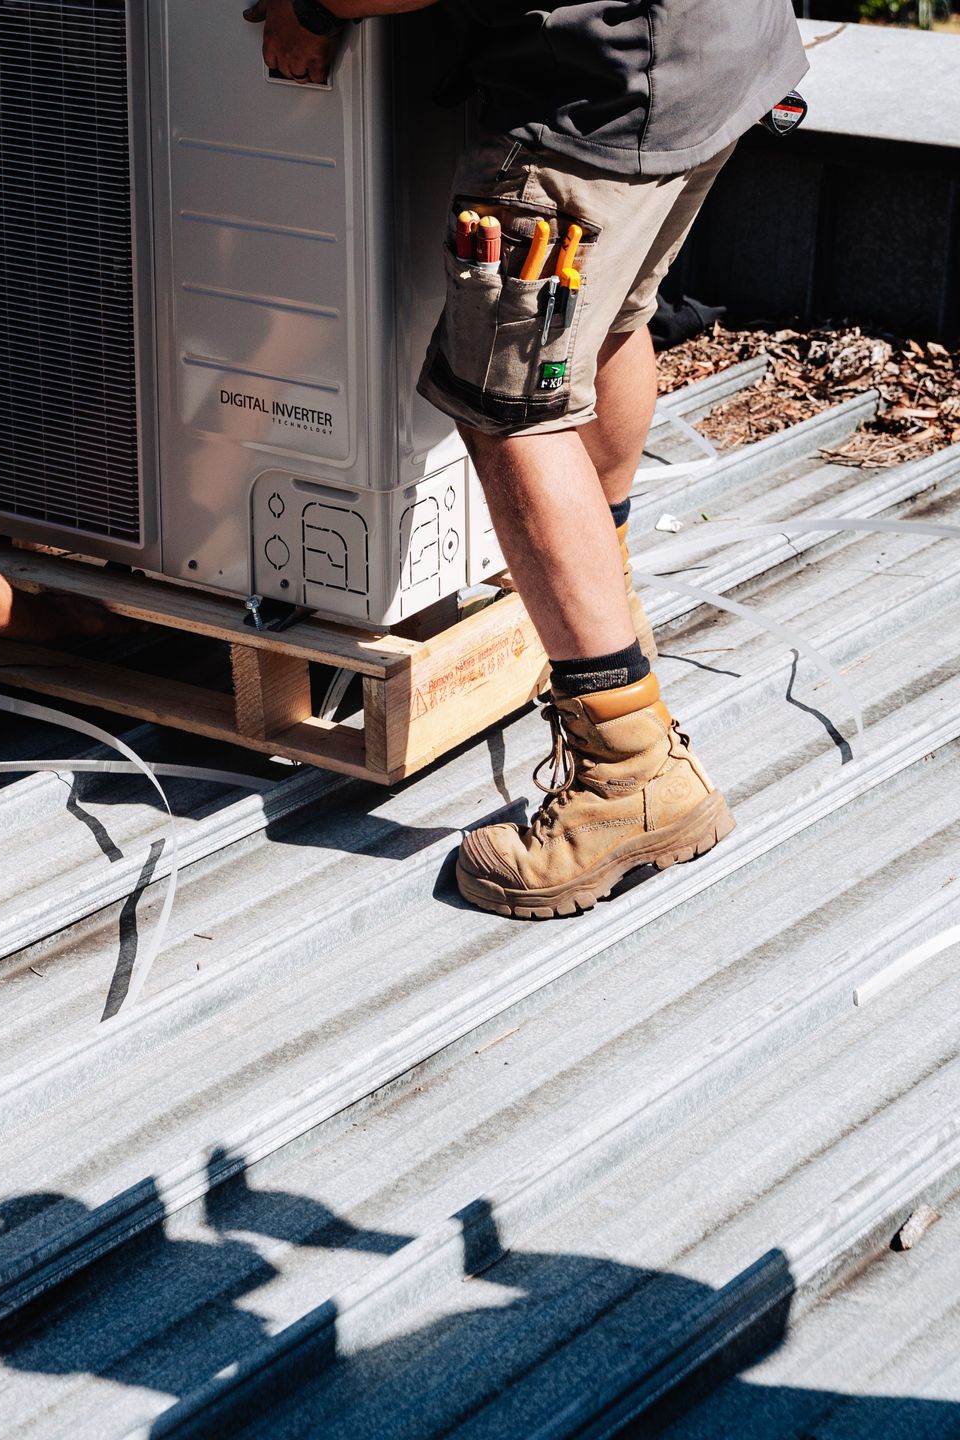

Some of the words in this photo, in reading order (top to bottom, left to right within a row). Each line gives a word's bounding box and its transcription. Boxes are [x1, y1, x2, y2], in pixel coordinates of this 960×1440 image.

[220, 389, 269, 414] DIGITAL
[272, 401, 333, 428] INVERTER
[272, 417, 333, 436] TECHNOLOGY
